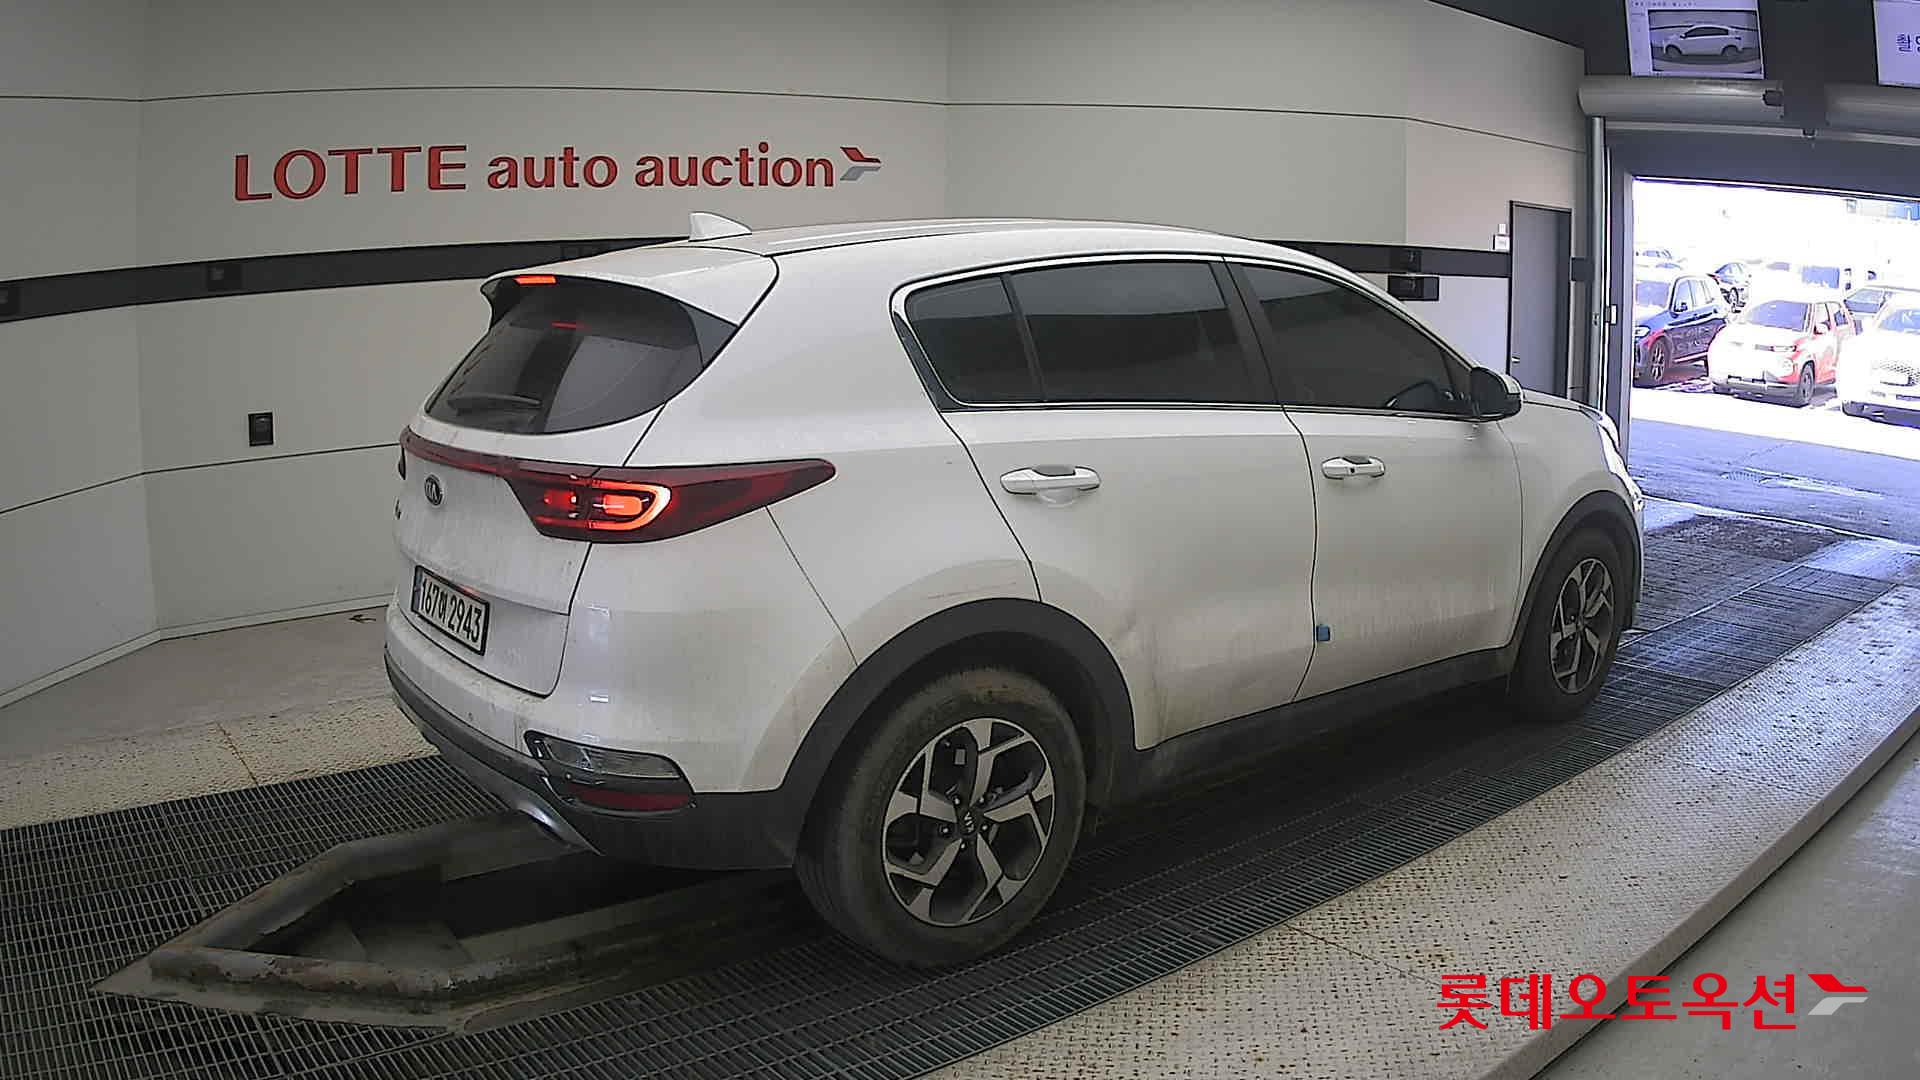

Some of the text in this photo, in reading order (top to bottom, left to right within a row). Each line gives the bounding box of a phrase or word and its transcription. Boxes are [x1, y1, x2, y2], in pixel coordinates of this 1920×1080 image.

[234, 142, 835, 201] LOTTE auto auction
